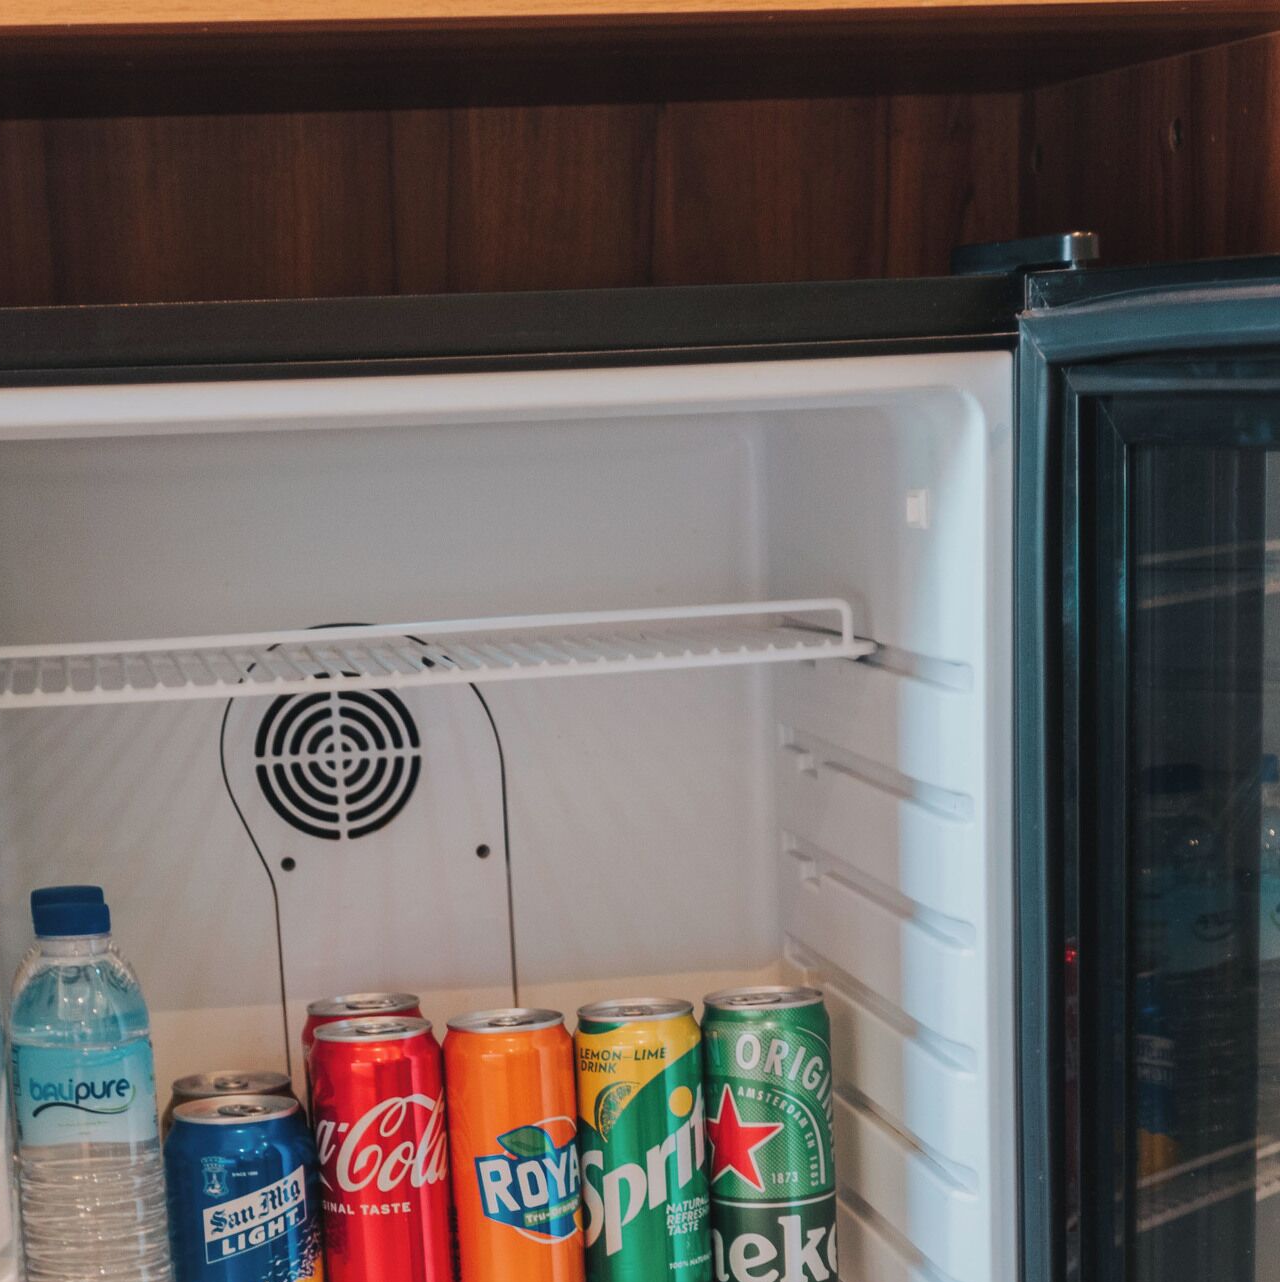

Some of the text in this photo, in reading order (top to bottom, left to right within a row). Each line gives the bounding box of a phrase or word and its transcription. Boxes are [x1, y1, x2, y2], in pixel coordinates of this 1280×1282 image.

[581, 1060, 616, 1073] DRINK
[30, 1078, 130, 1104] balipure
[737, 1086, 808, 1129] AMSTERDAM
[317, 1087, 447, 1192] a-Cola
[479, 1143, 581, 1214] ROYA
[581, 1082, 705, 1257] Sprit
[771, 1171, 798, 1184] 1873
[210, 1180, 301, 1235] San Mig
[360, 1202, 411, 1216] TASTE
[668, 1220, 699, 1236] TASTE
[222, 1207, 300, 1256] LIGHT
